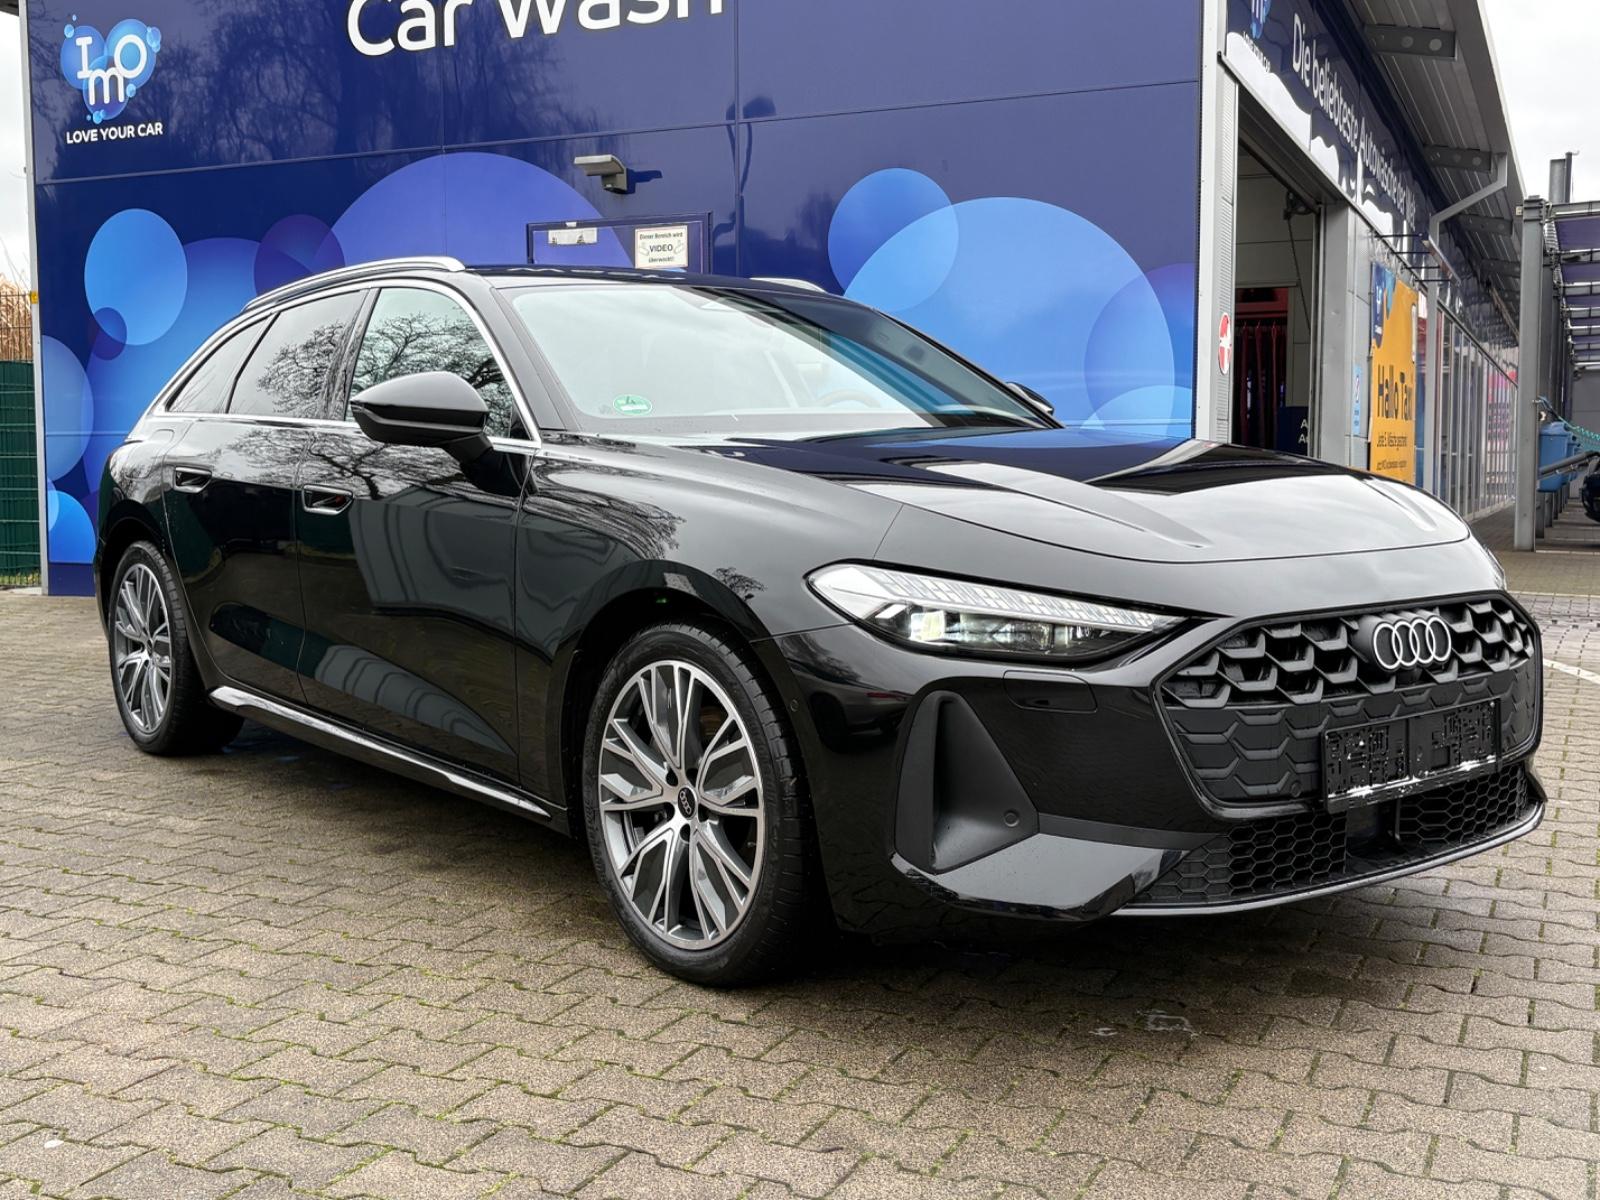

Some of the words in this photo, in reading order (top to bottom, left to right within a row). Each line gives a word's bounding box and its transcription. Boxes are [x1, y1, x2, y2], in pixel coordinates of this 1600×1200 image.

[347, 0, 474, 56] Car
[1293, 12, 1311, 89] Die
[1312, 39, 1359, 152] beliebteste
[66, 129, 98, 144] LOVE
[100, 125, 135, 141] YOUR
[137, 122, 163, 137] CAR
[649, 243, 674, 252] VIDEO
